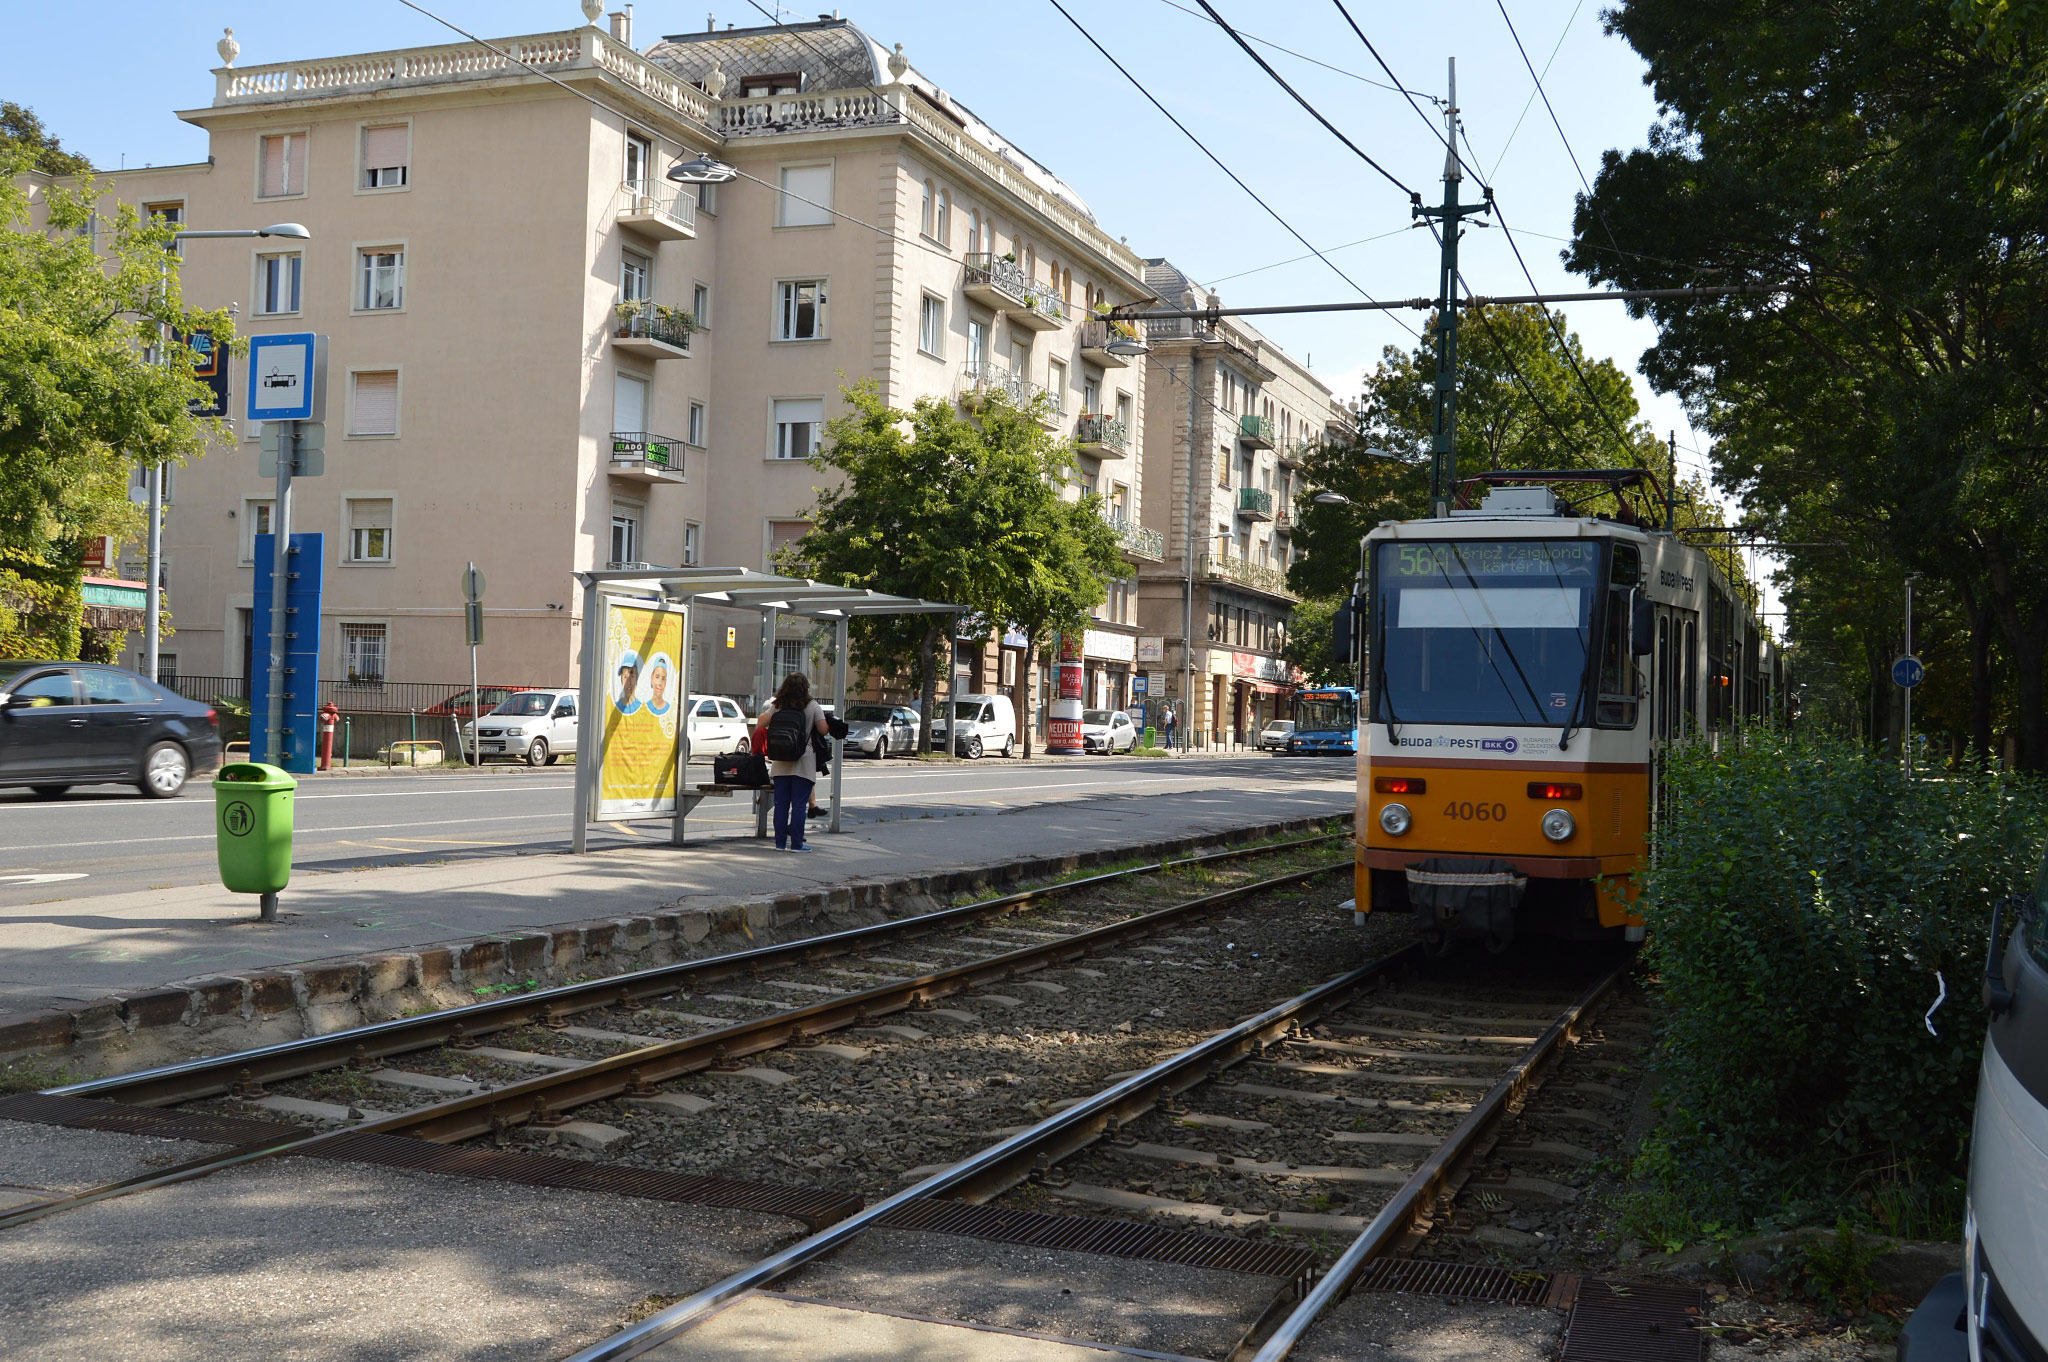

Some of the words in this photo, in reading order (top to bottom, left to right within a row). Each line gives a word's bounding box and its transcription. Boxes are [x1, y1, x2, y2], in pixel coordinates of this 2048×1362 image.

[1508, 545, 1582, 561] Zsigmond
[1049, 722, 1079, 734] NEOTON
[1484, 741, 1502, 749] BKK
[1443, 801, 1507, 822] 4060
